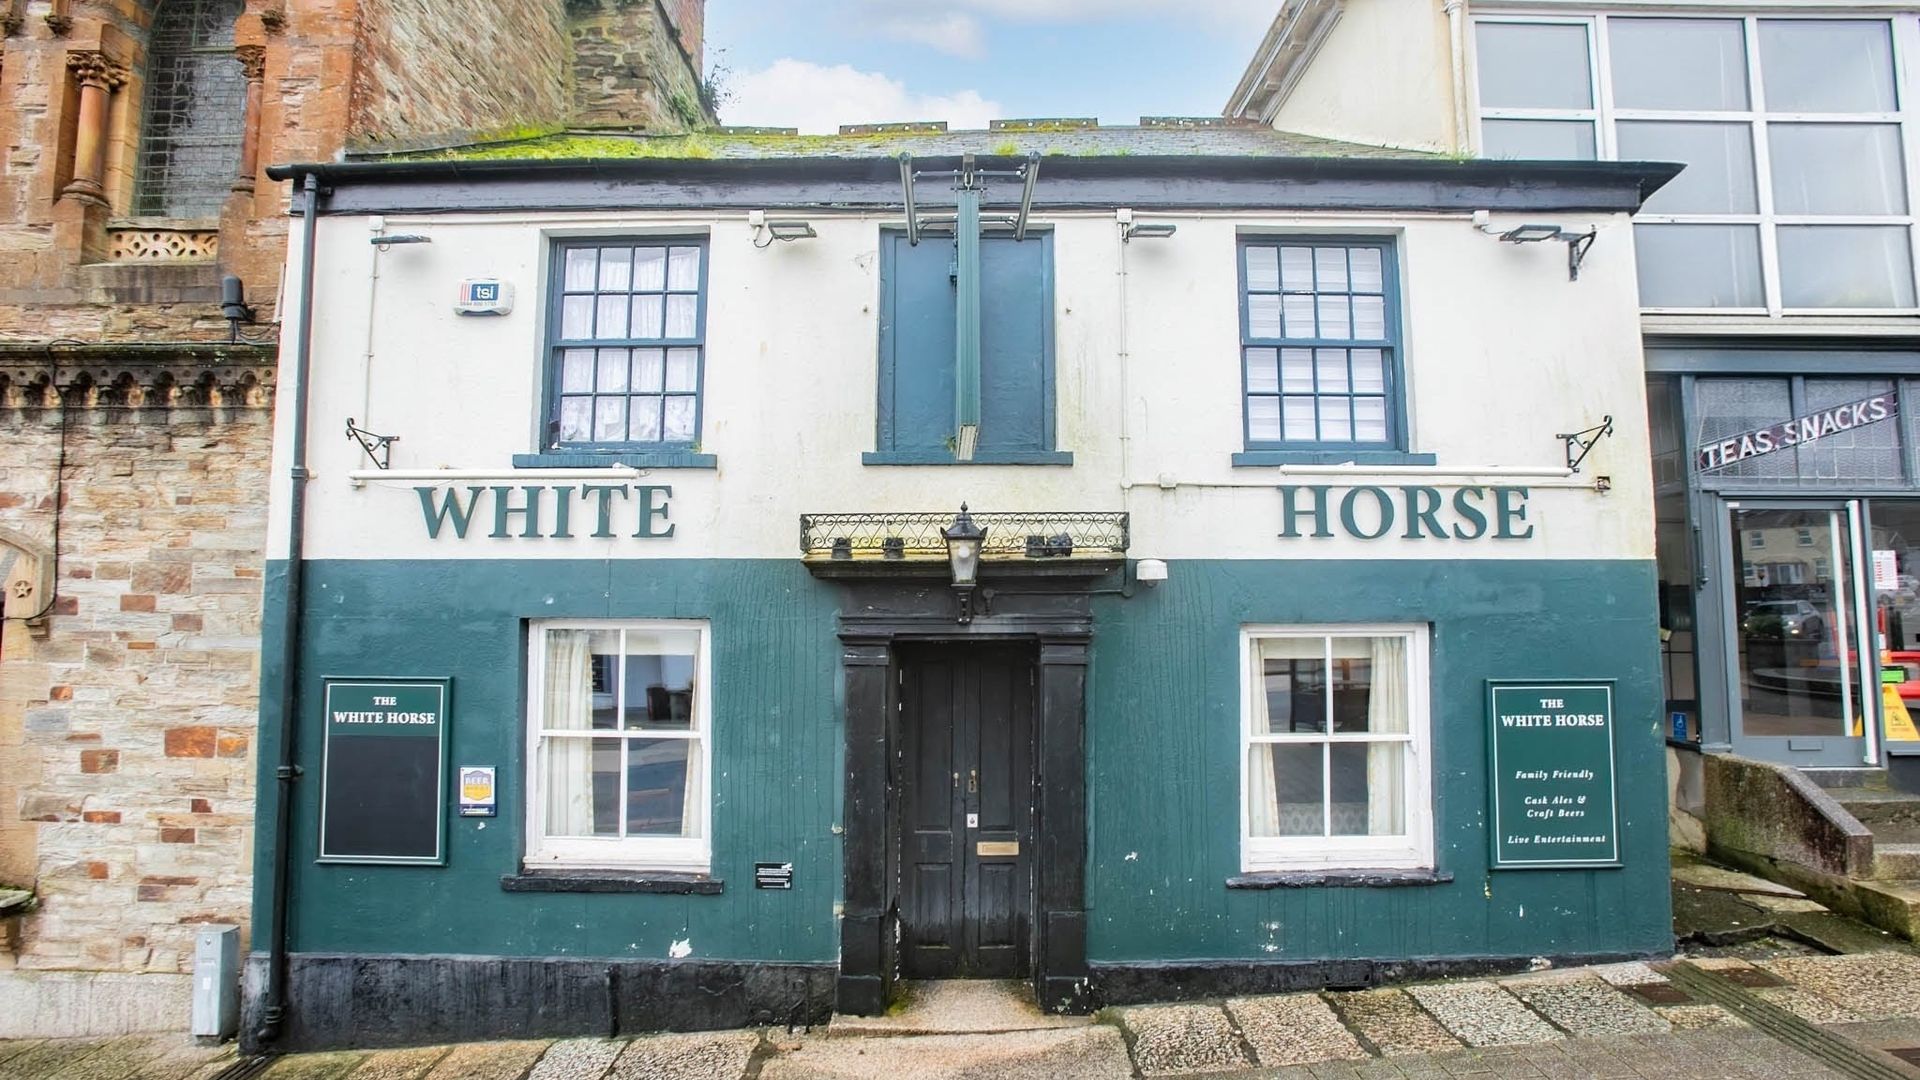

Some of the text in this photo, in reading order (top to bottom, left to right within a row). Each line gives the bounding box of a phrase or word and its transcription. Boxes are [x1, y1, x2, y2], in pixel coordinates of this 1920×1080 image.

[476, 286, 494, 299] tsi
[1784, 397, 1888, 444] SNACKS
[413, 484, 1534, 540] WHITE HORSE
[373, 696, 397, 706] THE
[1540, 699, 1564, 709] THE
[333, 711, 436, 725] WHITE HORSE
[1501, 714, 1605, 727] WHITE HORSE
[1515, 769, 1594, 781] Family Friendly
[1524, 795, 1586, 805] Cask Ales &
[1526, 809, 1585, 820] Craft Beers
[1507, 834, 1606, 844] Live Entertainment
